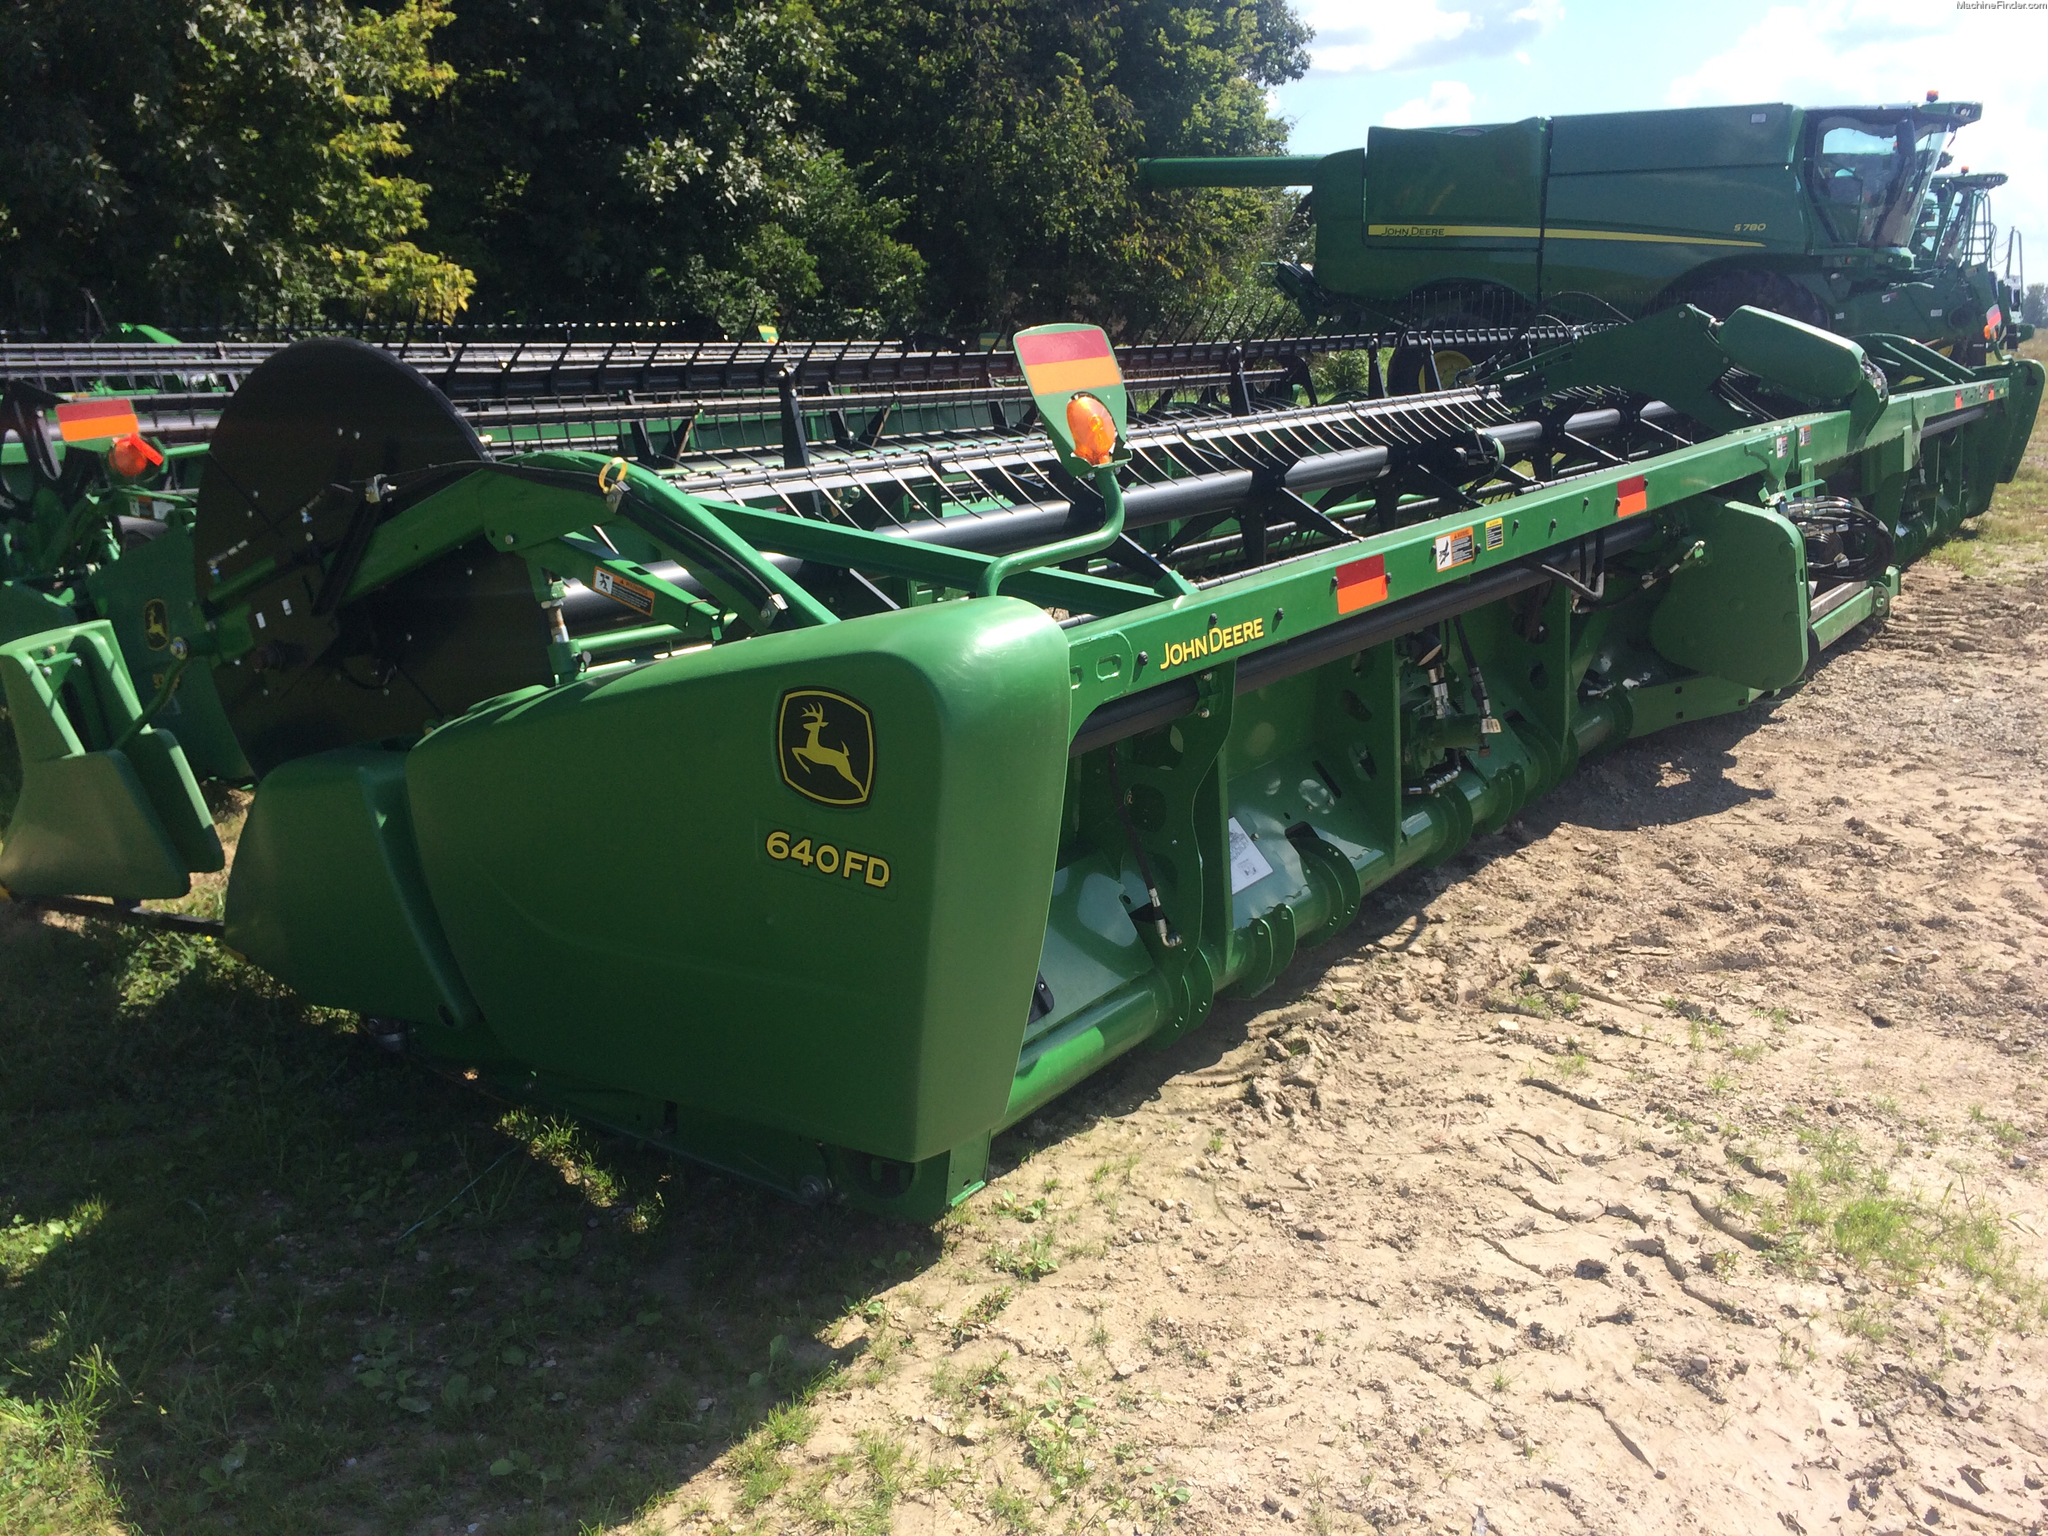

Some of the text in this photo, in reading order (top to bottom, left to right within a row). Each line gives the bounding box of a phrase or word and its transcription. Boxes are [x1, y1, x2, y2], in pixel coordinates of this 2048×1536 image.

[1381, 226, 1445, 237] JOHN DEERE
[1159, 617, 1265, 671] JOHN DEERE
